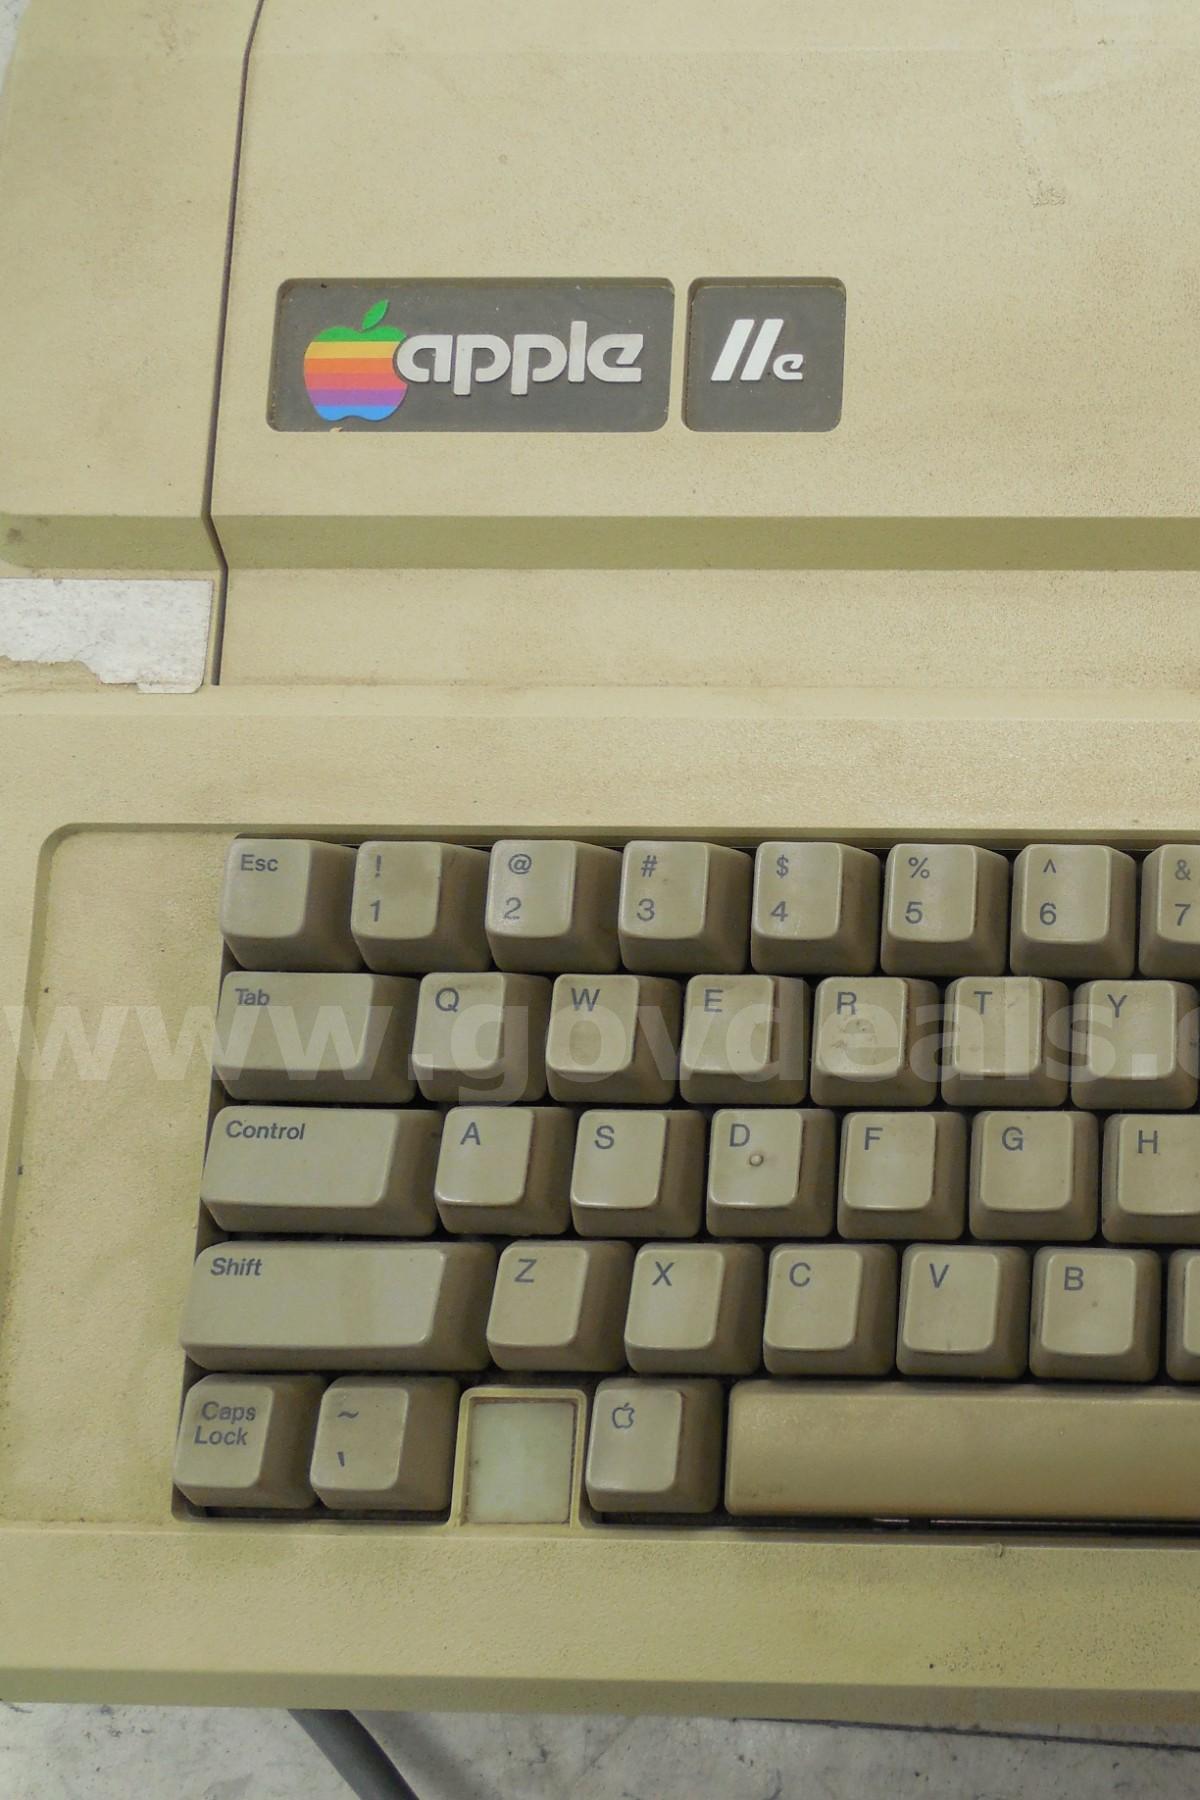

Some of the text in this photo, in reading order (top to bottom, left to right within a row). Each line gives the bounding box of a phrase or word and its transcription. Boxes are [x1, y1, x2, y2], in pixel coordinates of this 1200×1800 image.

[397, 320, 644, 396] apple
[240, 853, 279, 872] Esc
[374, 854, 382, 878] !
[507, 853, 533, 875] @
[640, 854, 658, 878] #
[776, 854, 789, 879] $
[907, 856, 930, 880] %
[1174, 858, 1192, 881] &
[369, 899, 381, 923] 1
[503, 896, 522, 920] 2
[636, 898, 655, 922] 3
[769, 900, 789, 922] 4
[904, 901, 923, 925] 5
[1039, 902, 1057, 926] 6
[1174, 903, 1192, 927] 7
[234, 987, 271, 1007] Tab
[434, 987, 460, 1013] Q
[570, 987, 601, 1012] W
[703, 988, 724, 1013] E
[836, 991, 857, 1015] R
[973, 990, 993, 1015] T
[1106, 993, 1128, 1019] Y
[225, 1119, 306, 1141] Control
[459, 1121, 481, 1146] A
[594, 1124, 615, 1150] S
[729, 1123, 751, 1148] D
[864, 1126, 884, 1151] F
[1001, 1126, 1024, 1152] G
[1137, 1129, 1159, 1155] H
[210, 1257, 263, 1277] Shift
[514, 1258, 538, 1284] Z
[651, 1261, 675, 1287] X
[789, 1262, 811, 1288] C
[929, 1263, 950, 1289] V
[1063, 1266, 1084, 1291] B
[200, 1400, 257, 1422] Caps
[193, 1425, 249, 1446] Lock
